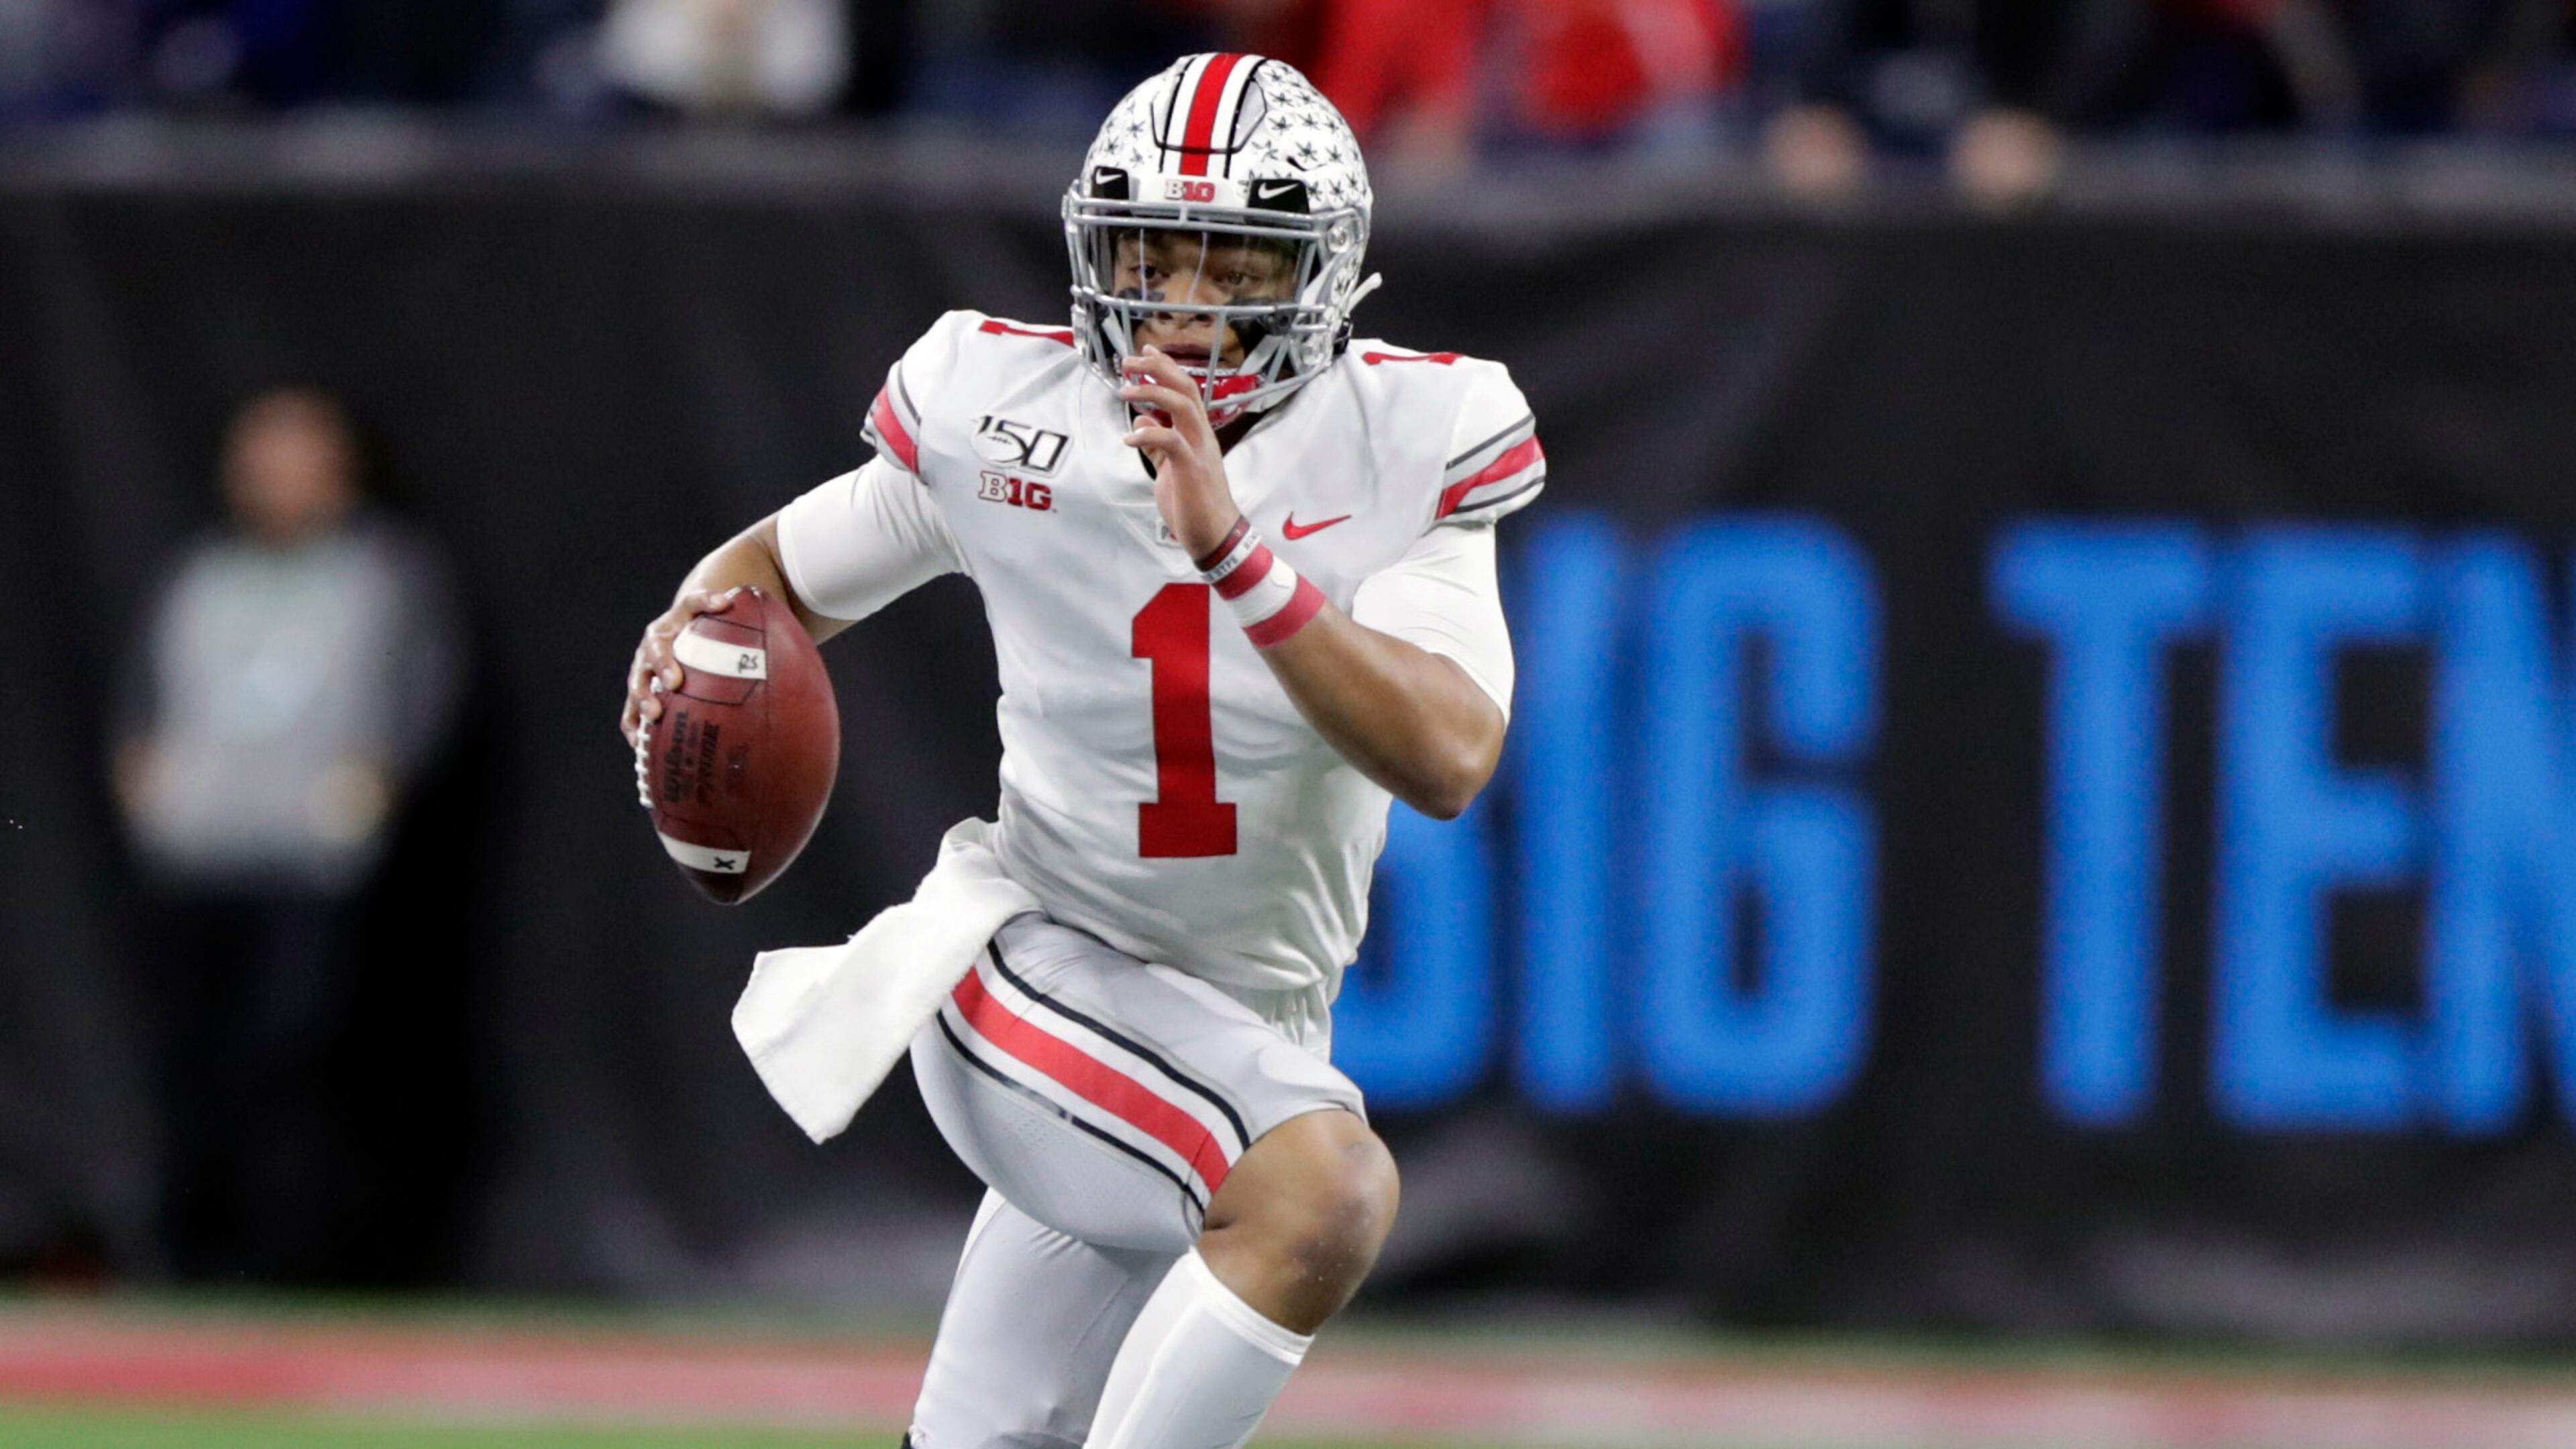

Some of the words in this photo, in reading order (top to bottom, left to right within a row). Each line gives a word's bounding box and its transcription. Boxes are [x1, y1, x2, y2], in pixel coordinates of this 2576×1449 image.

[977, 415, 1069, 472] 150
[1132, 582, 1237, 857] 1
[1989, 515, 2576, 1130] TEN
